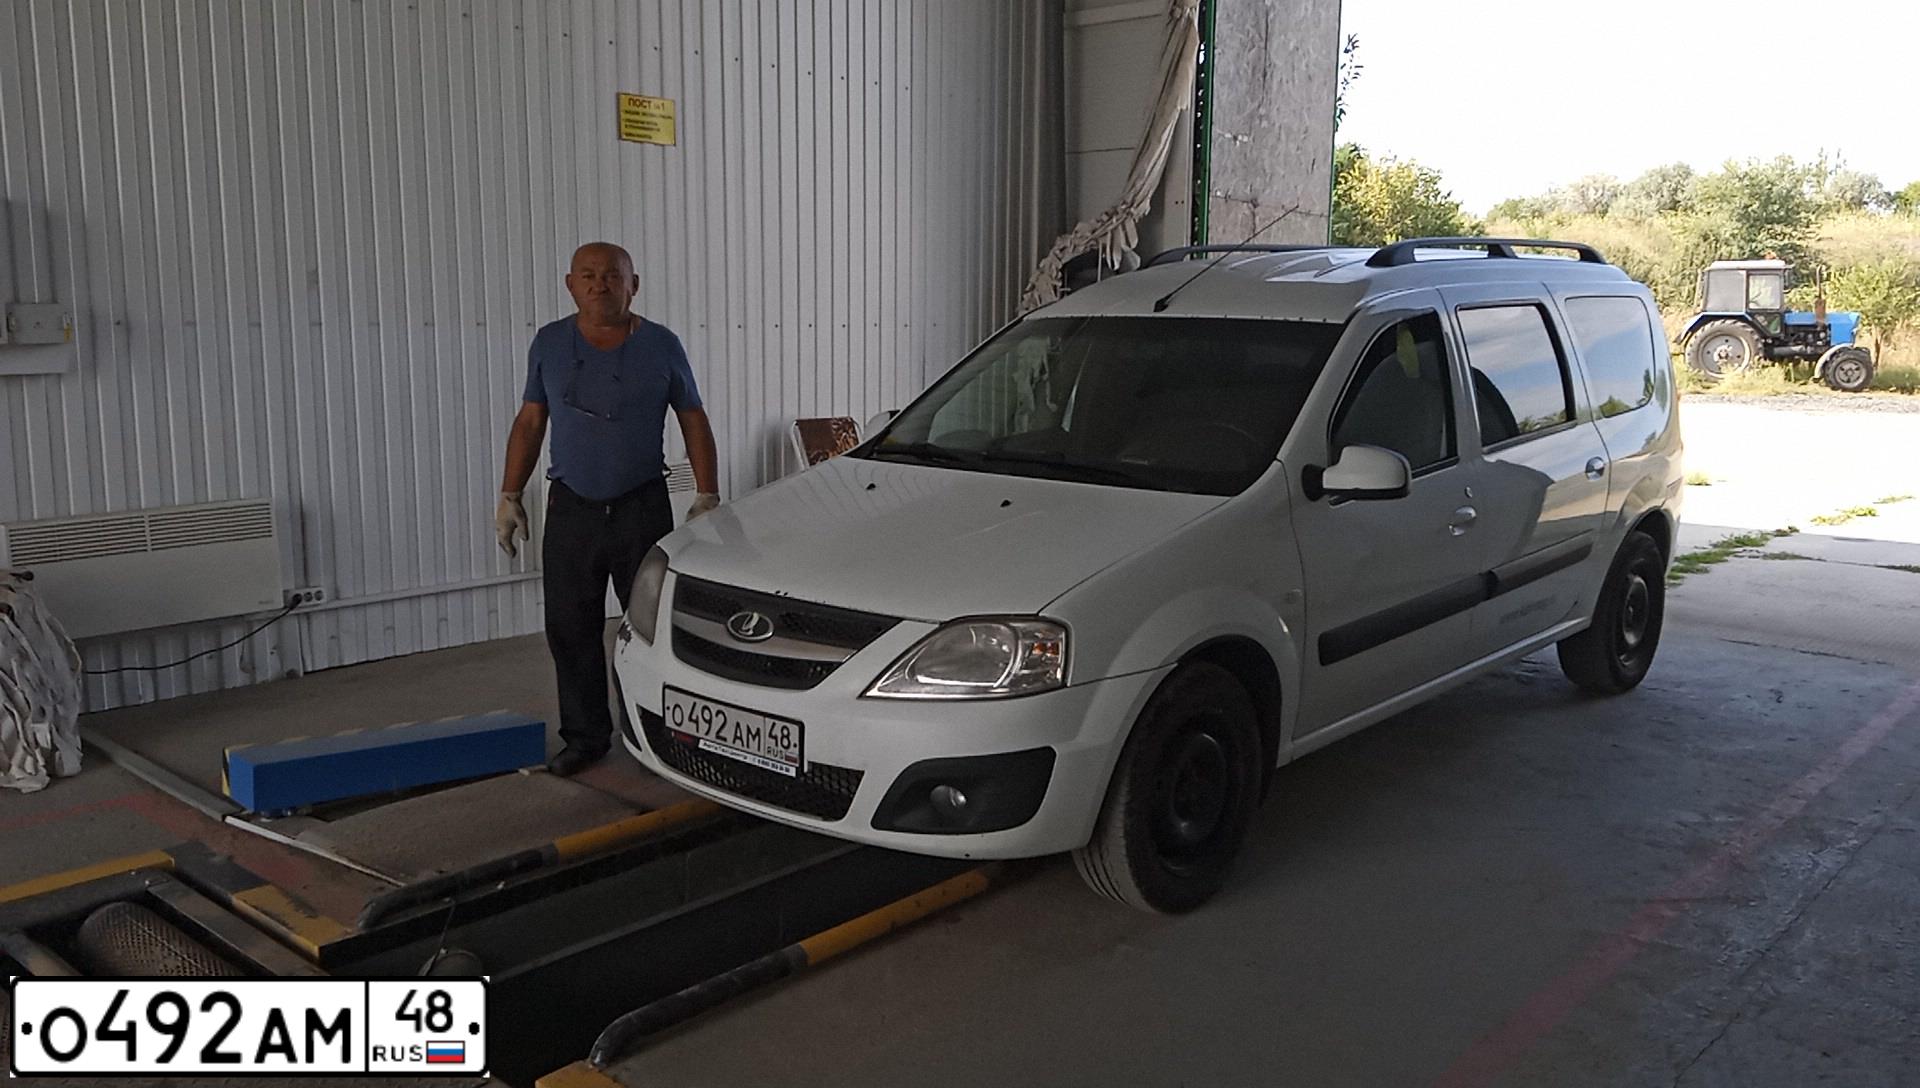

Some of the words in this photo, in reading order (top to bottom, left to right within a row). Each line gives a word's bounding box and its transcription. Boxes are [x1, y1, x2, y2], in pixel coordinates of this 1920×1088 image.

[628, 97, 651, 109] ПОСТ
[768, 721, 791, 750] 48
[766, 746, 784, 760] RUS
